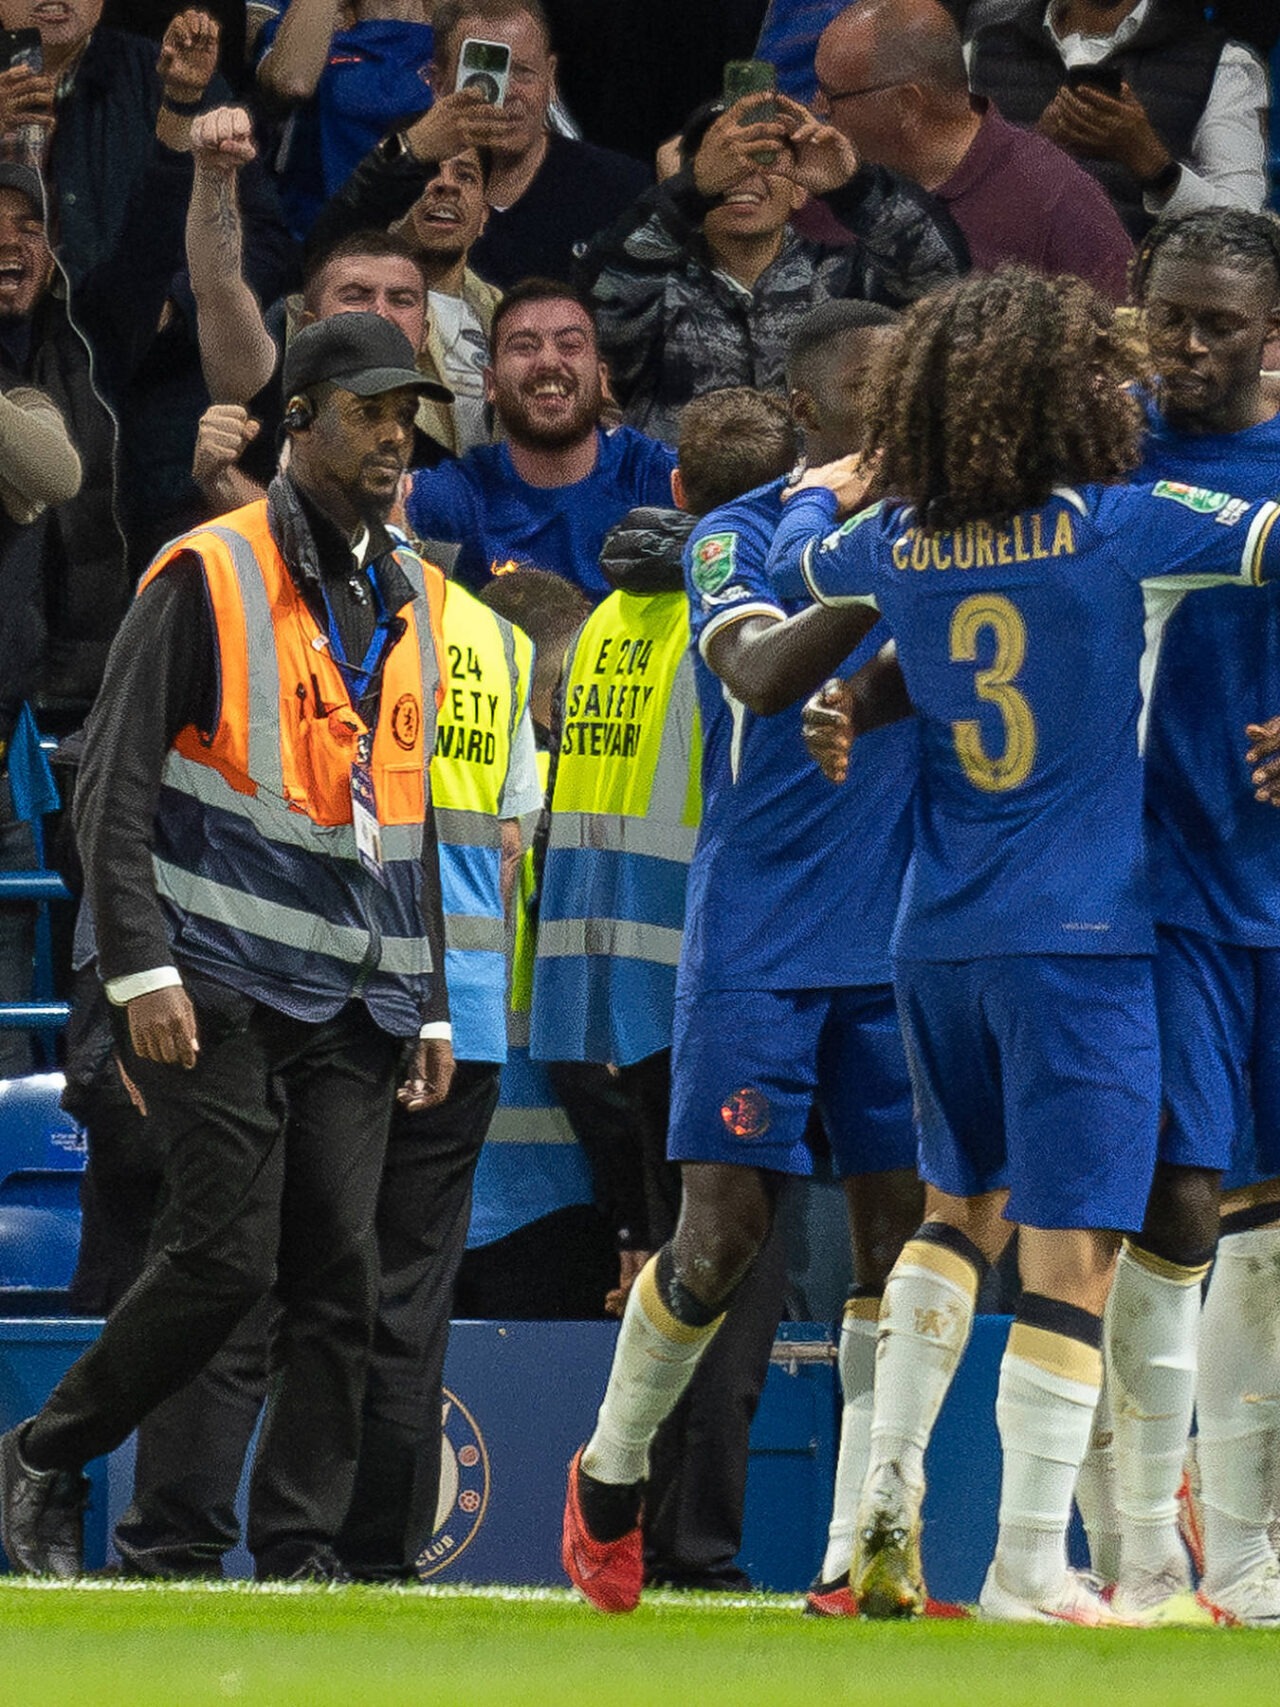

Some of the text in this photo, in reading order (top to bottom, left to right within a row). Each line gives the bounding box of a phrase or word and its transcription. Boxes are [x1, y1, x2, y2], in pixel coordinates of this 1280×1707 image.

[892, 510, 1075, 571] CUCURELLA
[593, 638, 654, 676] E 204
[451, 688, 499, 729] ETY
[949, 593, 1037, 794] 3
[434, 725, 496, 766] WARD
